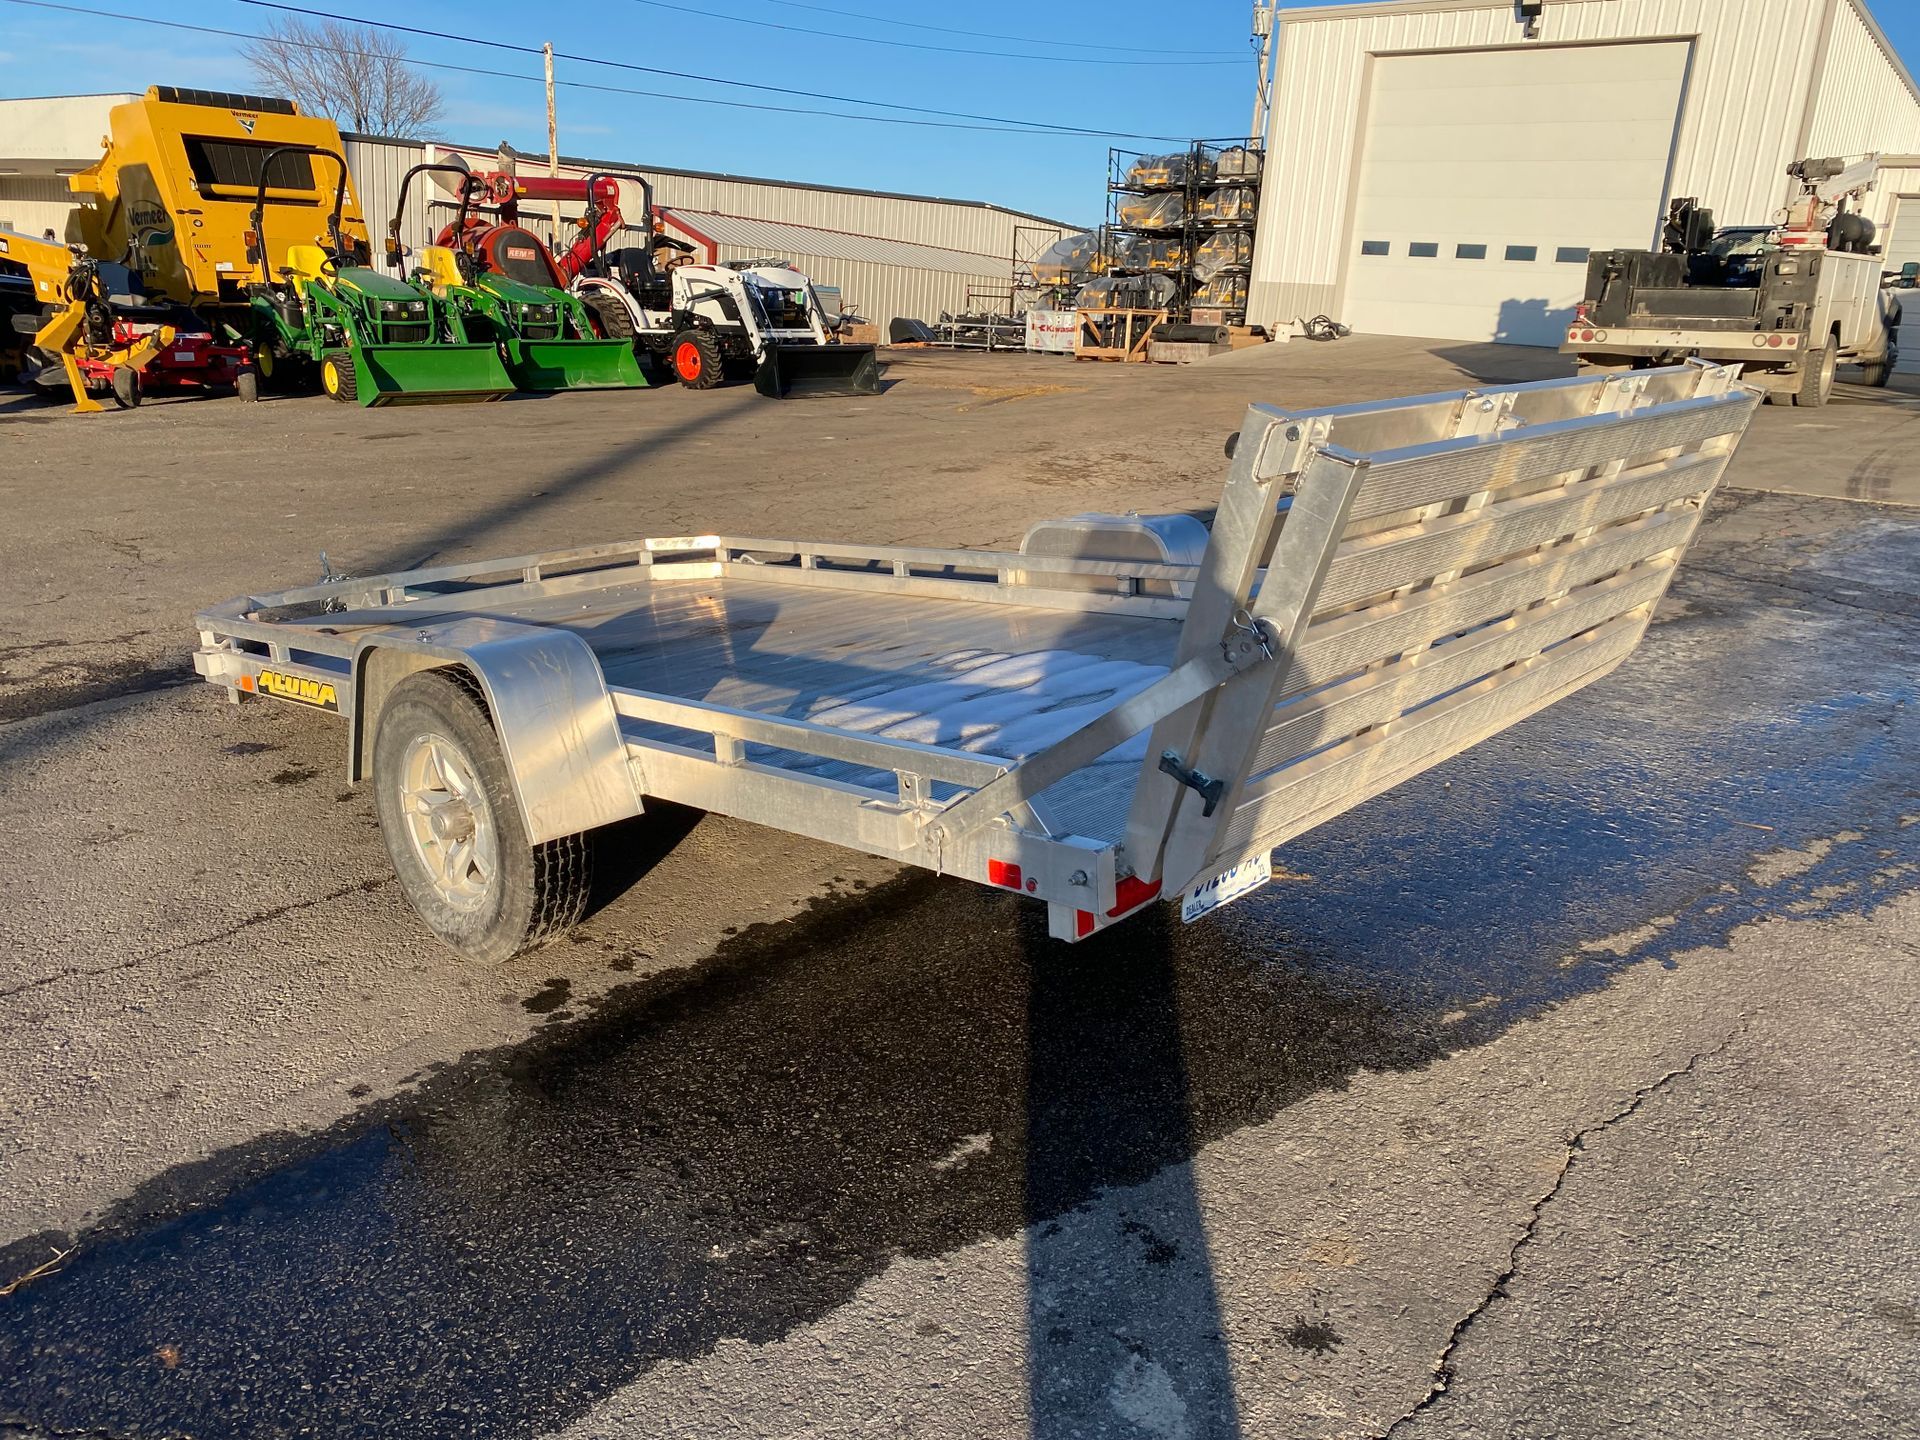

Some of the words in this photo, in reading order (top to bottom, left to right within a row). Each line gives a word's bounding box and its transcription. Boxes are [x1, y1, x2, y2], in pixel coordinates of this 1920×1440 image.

[231, 110, 259, 118] Vermeer
[128, 207, 167, 226] Vermeer
[259, 670, 336, 705] ALUMA
